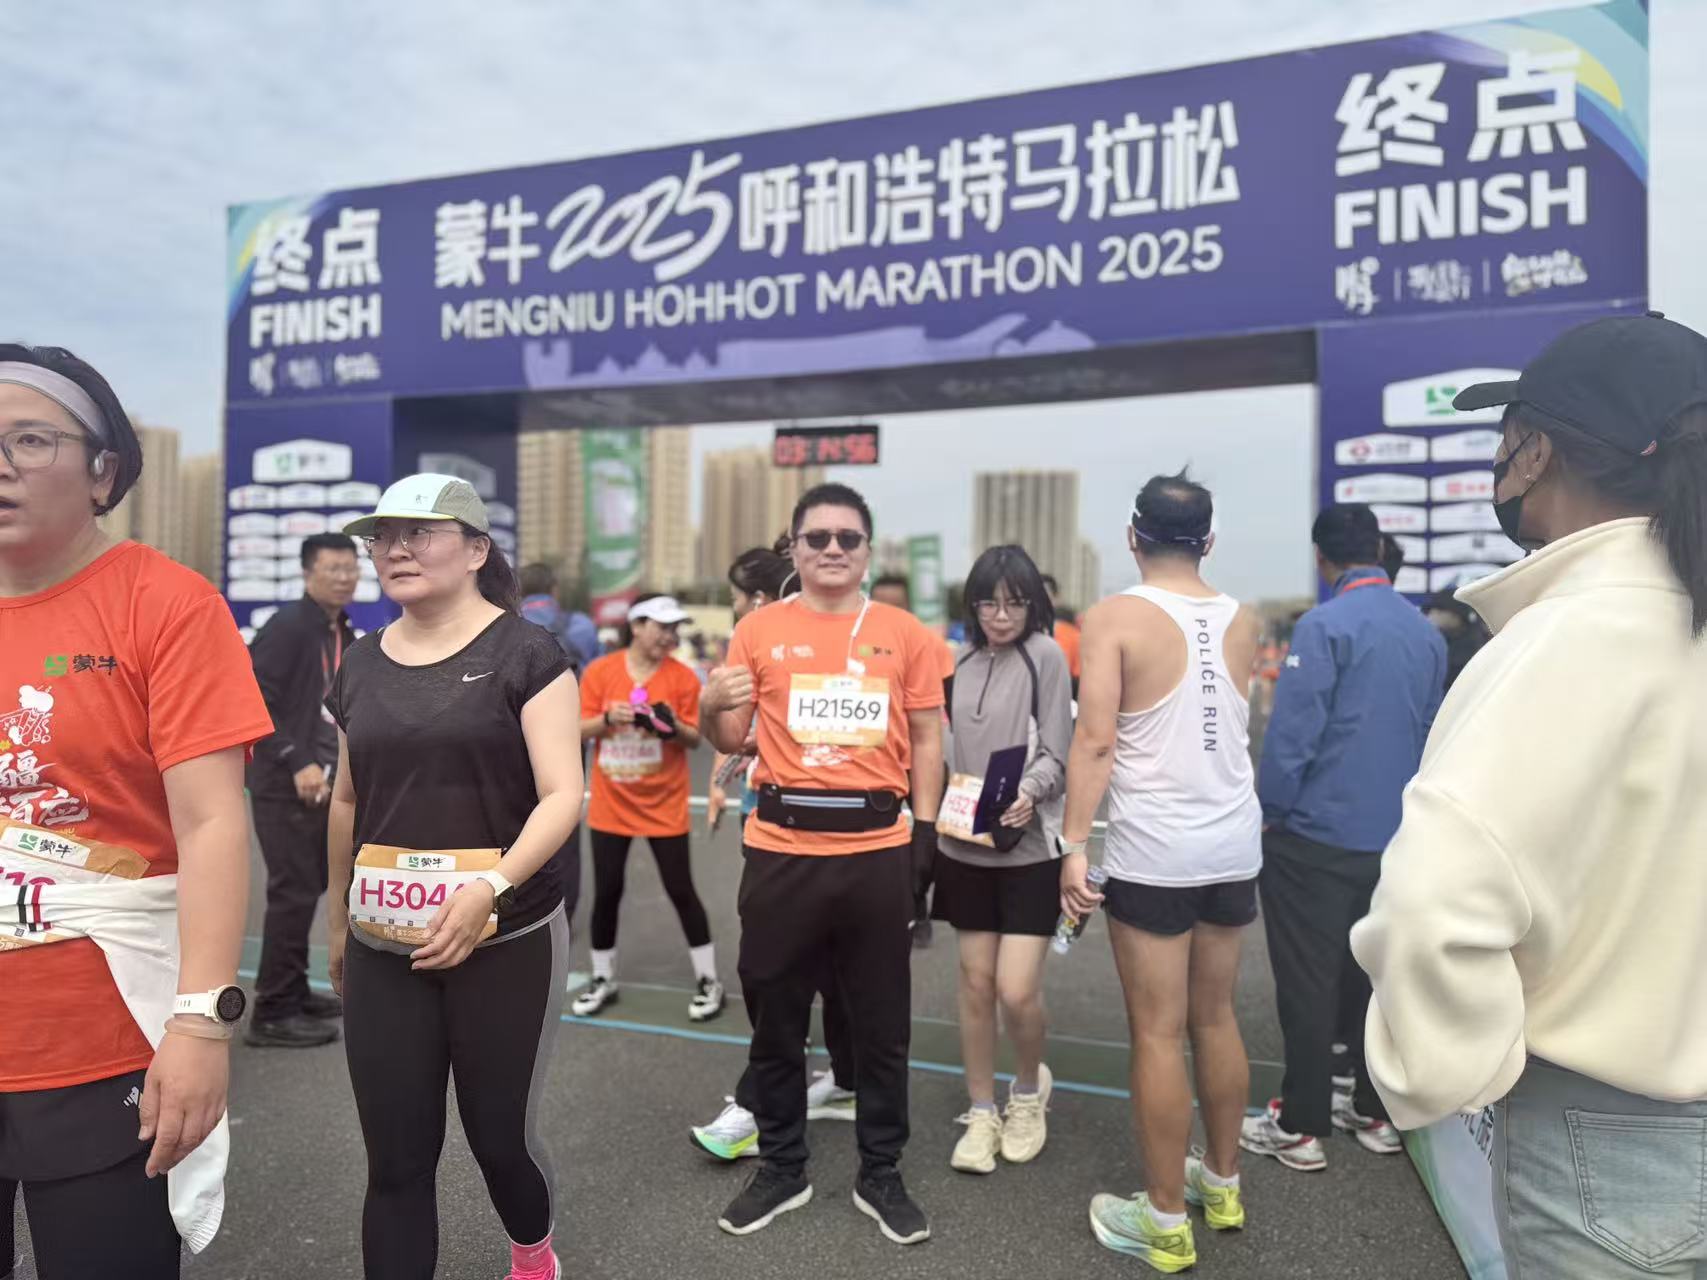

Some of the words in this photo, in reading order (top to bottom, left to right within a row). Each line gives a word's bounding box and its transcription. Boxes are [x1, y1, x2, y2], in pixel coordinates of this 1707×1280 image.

[1335, 47, 1587, 177] 终点
[1334, 166, 1588, 249] FINISH
[249, 206, 383, 296] 终点
[440, 290, 614, 341] MENGNIU
[625, 273, 804, 329] HOHHOT
[816, 241, 1083, 313] MARATHON
[1098, 224, 1224, 283] 2025
[249, 293, 383, 348] FINISH
[73, 654, 118, 676] 蒙牛
[1195, 618, 1216, 695] POLICE
[798, 697, 881, 720] H21569
[1203, 706, 1217, 751] RUN
[39, 838, 73, 859] 蒙牛
[420, 856, 444, 869] 蒙牛
[360, 877, 465, 911] H304
